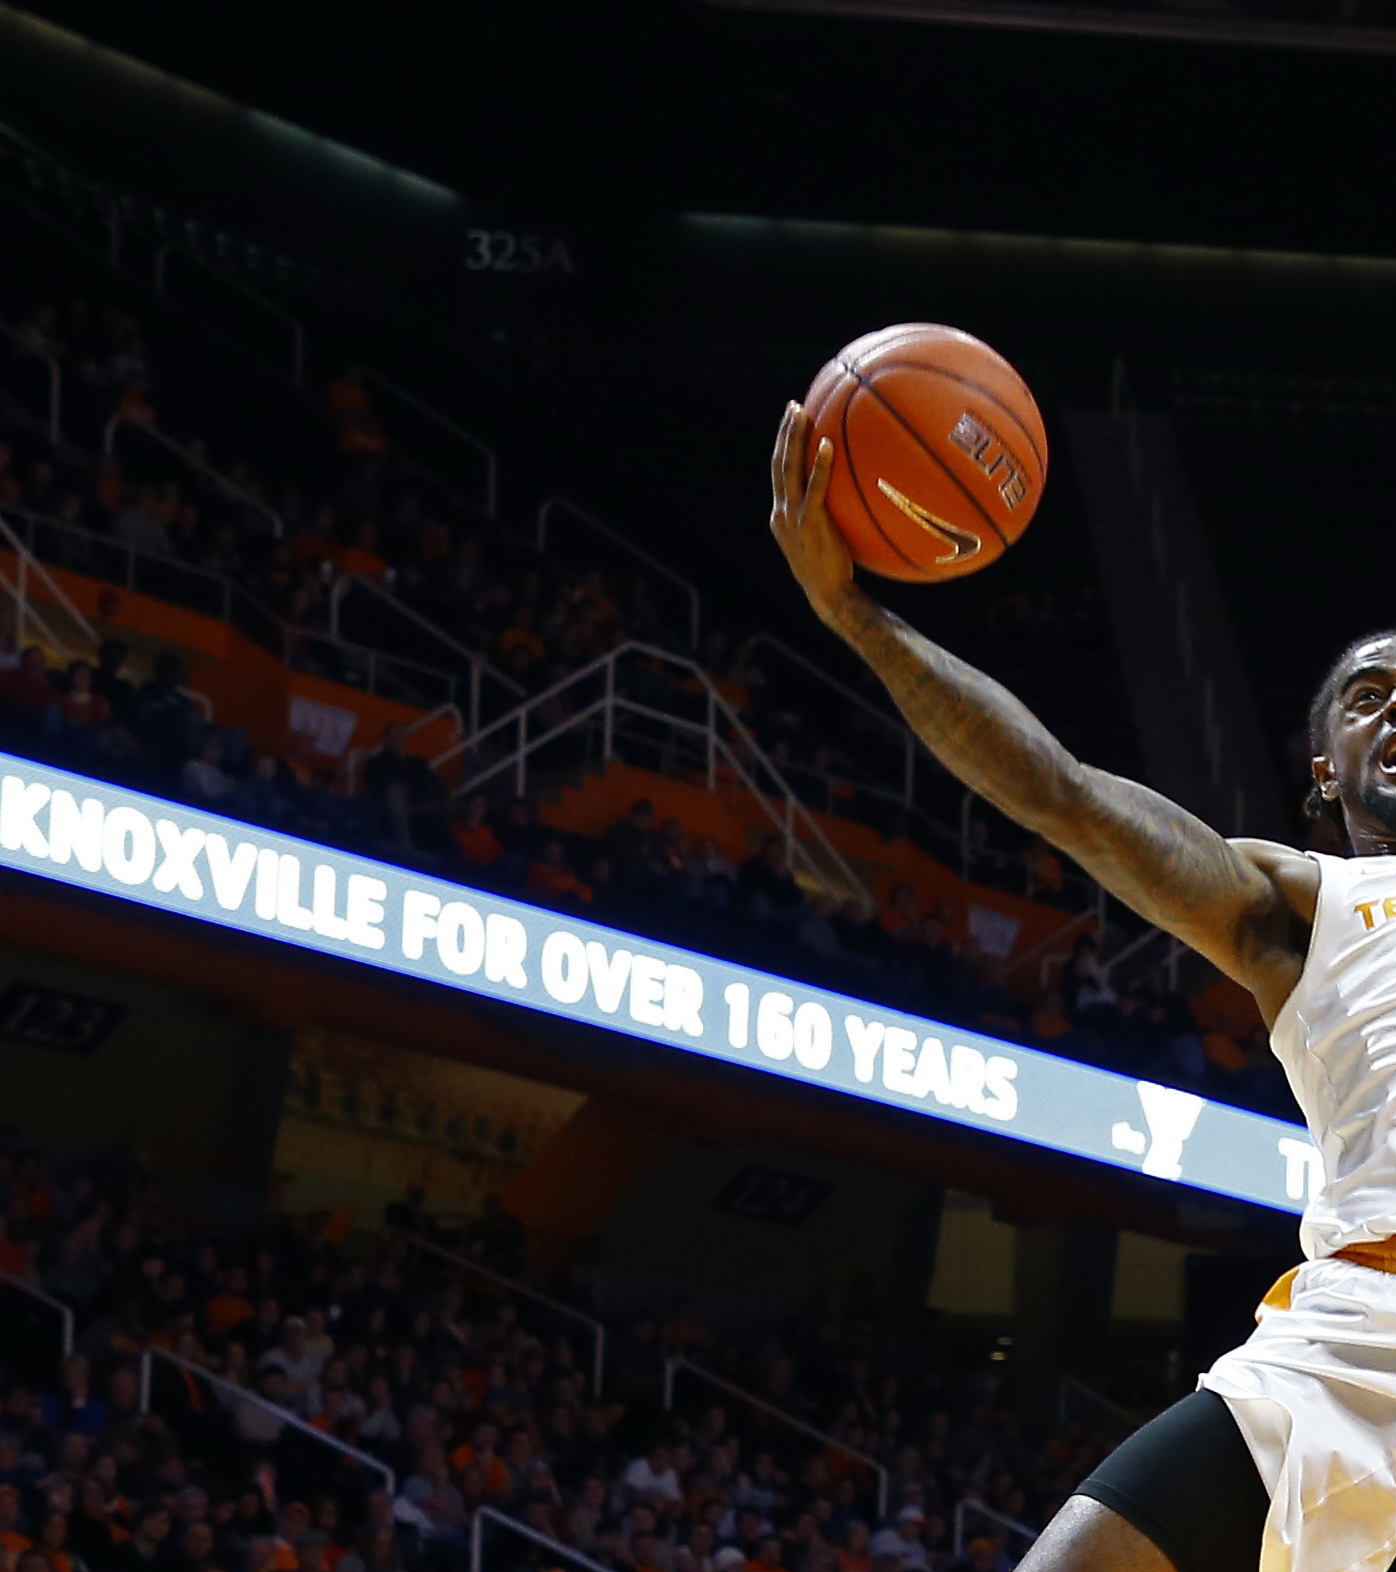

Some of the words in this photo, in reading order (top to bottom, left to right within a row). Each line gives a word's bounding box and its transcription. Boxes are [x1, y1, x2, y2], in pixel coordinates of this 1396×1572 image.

[465, 229, 576, 275] 325A
[1, 775, 388, 950] KNOXVILLE
[402, 889, 528, 989] FOR
[541, 930, 704, 1037] OVER
[724, 982, 833, 1071] 160
[844, 1014, 1019, 1122] YEARS
